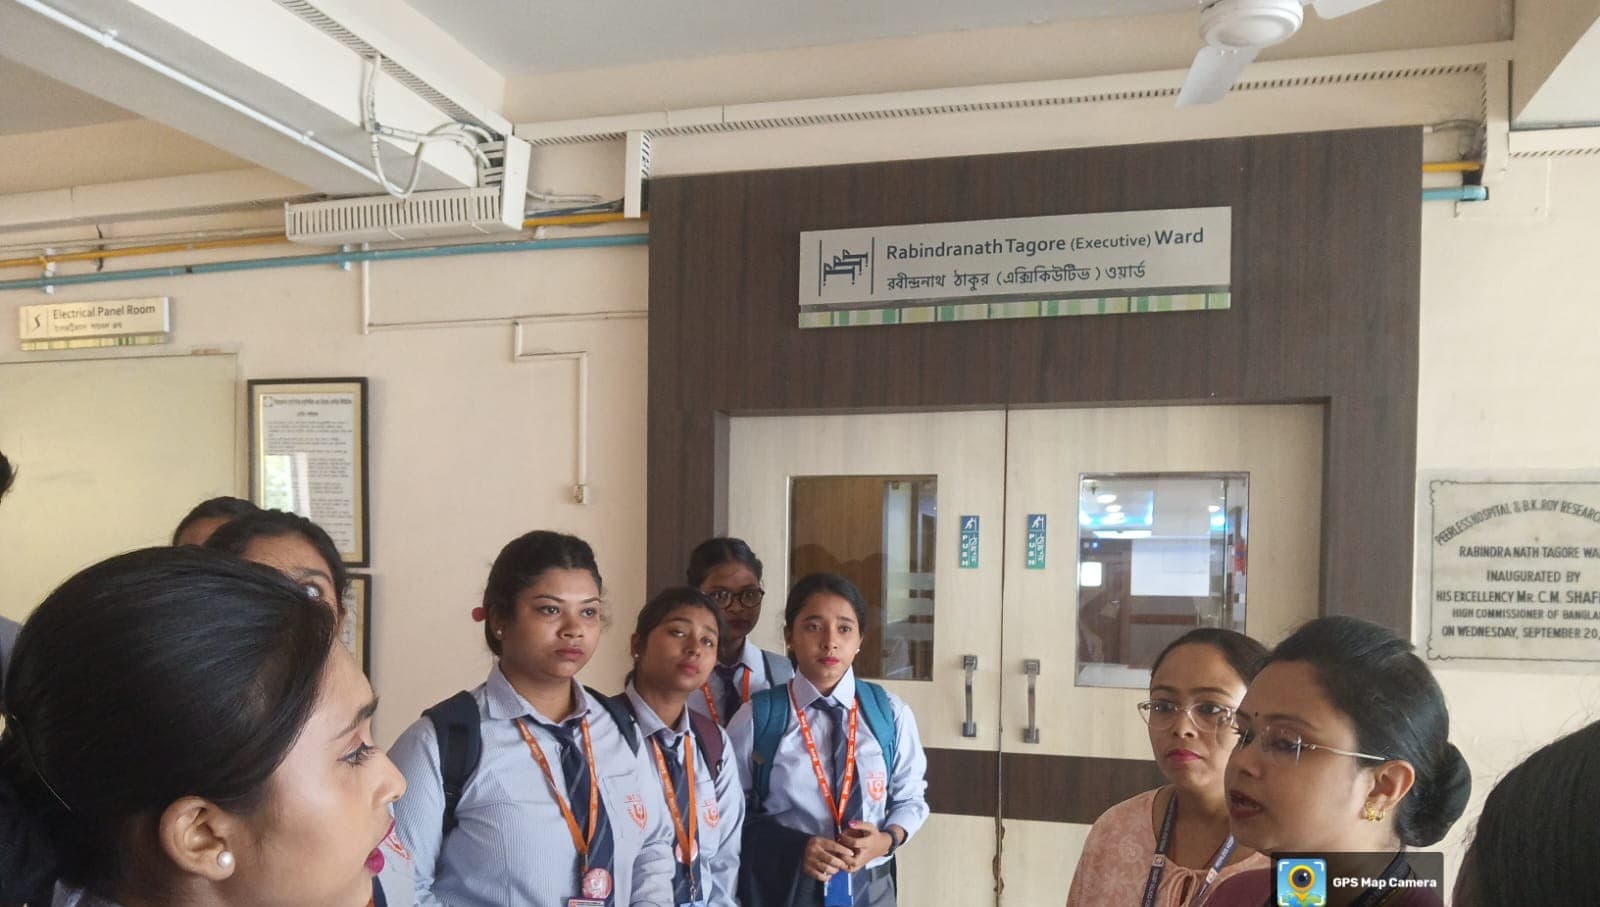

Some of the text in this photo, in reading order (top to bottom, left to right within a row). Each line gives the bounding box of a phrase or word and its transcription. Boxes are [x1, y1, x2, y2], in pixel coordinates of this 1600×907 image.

[886, 226, 1204, 260] Rabindranath Tagore (Executive) Ward
[886, 271, 947, 291] রবীন্দ্রনাথ
[953, 269, 990, 292] ঠাকুর
[53, 304, 156, 320] Electrical Panel Room
[1434, 516, 1473, 546] PEERLESS
[1471, 503, 1512, 524] HOSPITAL
[1560, 500, 1600, 522] RESEARC
[1542, 546, 1579, 559] TAGORE
[1583, 547, 1600, 559] WA
[1486, 569, 1581, 583] INAUGURATED BY
[1436, 590, 1452, 602] HIS
[1454, 590, 1514, 603] EXCELLENCY
[1566, 590, 1600, 604] SHAF
[1452, 608, 1600, 620] HIGH COMMISSIONER OF BANGLA
[1441, 625, 1455, 637] ON
[1457, 625, 1519, 640] WEDNESDAY,
[1522, 626, 1581, 638] SEPTEMBER
